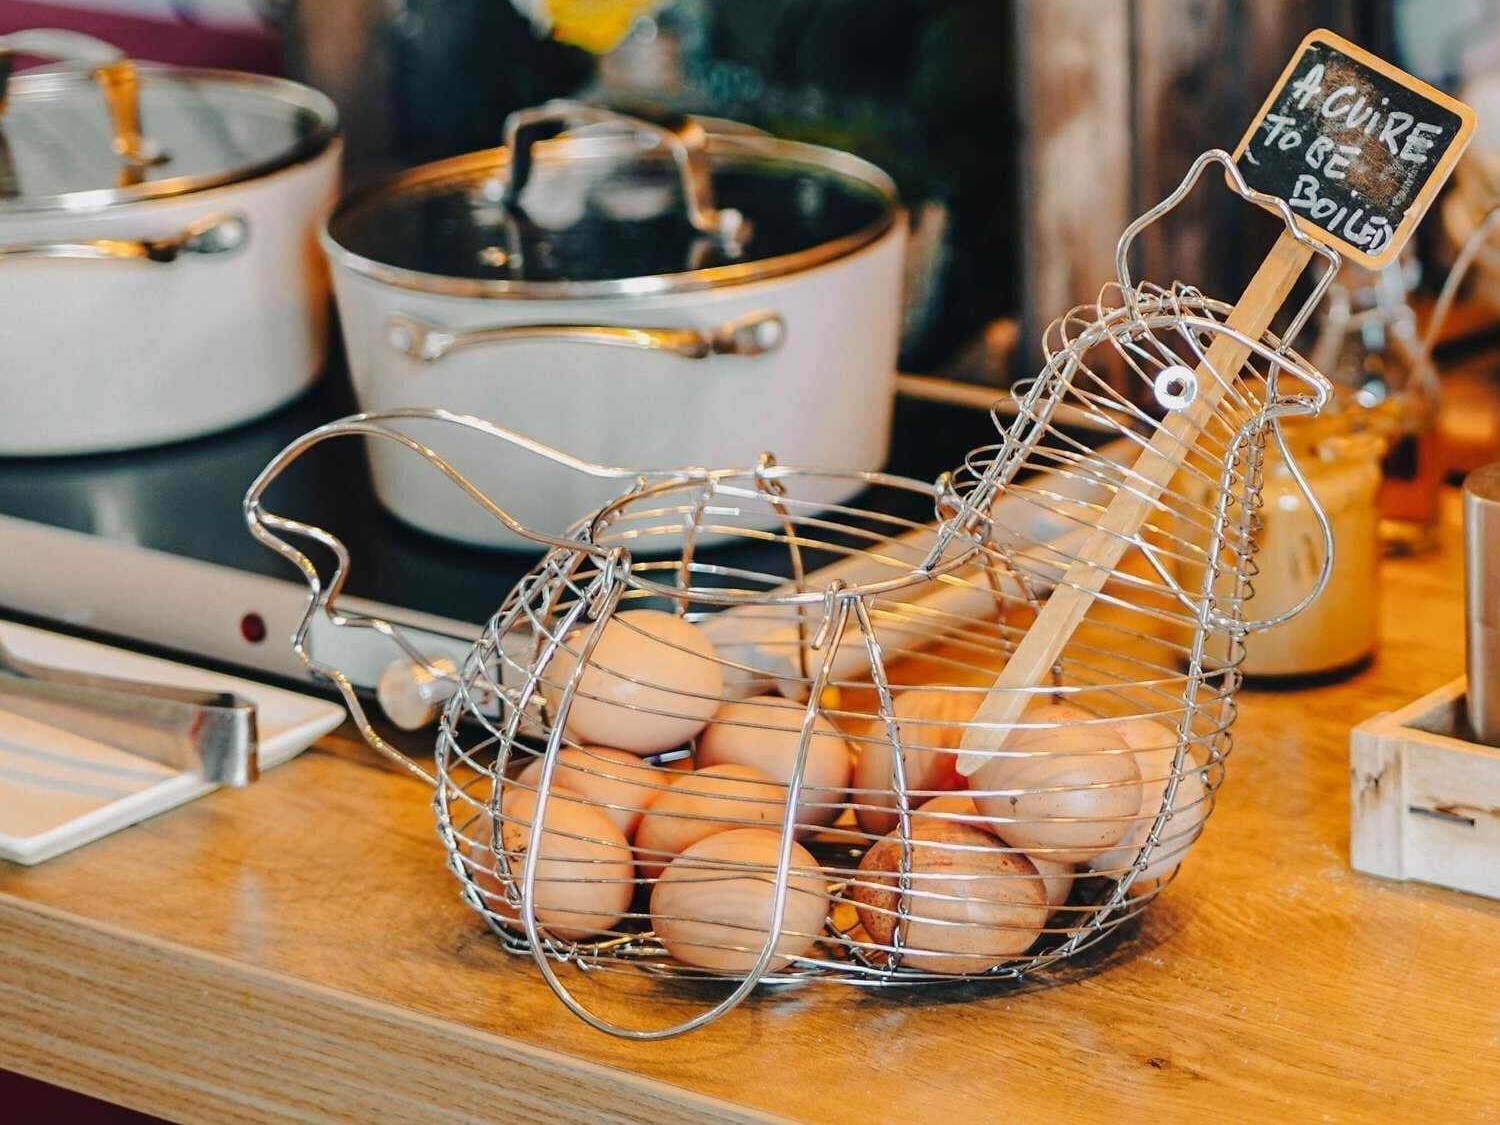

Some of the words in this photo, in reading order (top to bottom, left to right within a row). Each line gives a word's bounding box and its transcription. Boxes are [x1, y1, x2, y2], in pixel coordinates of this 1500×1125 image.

[1263, 113, 1302, 151] TO
[1304, 135, 1362, 180] BE
[1320, 86, 1443, 164] CUIRE
